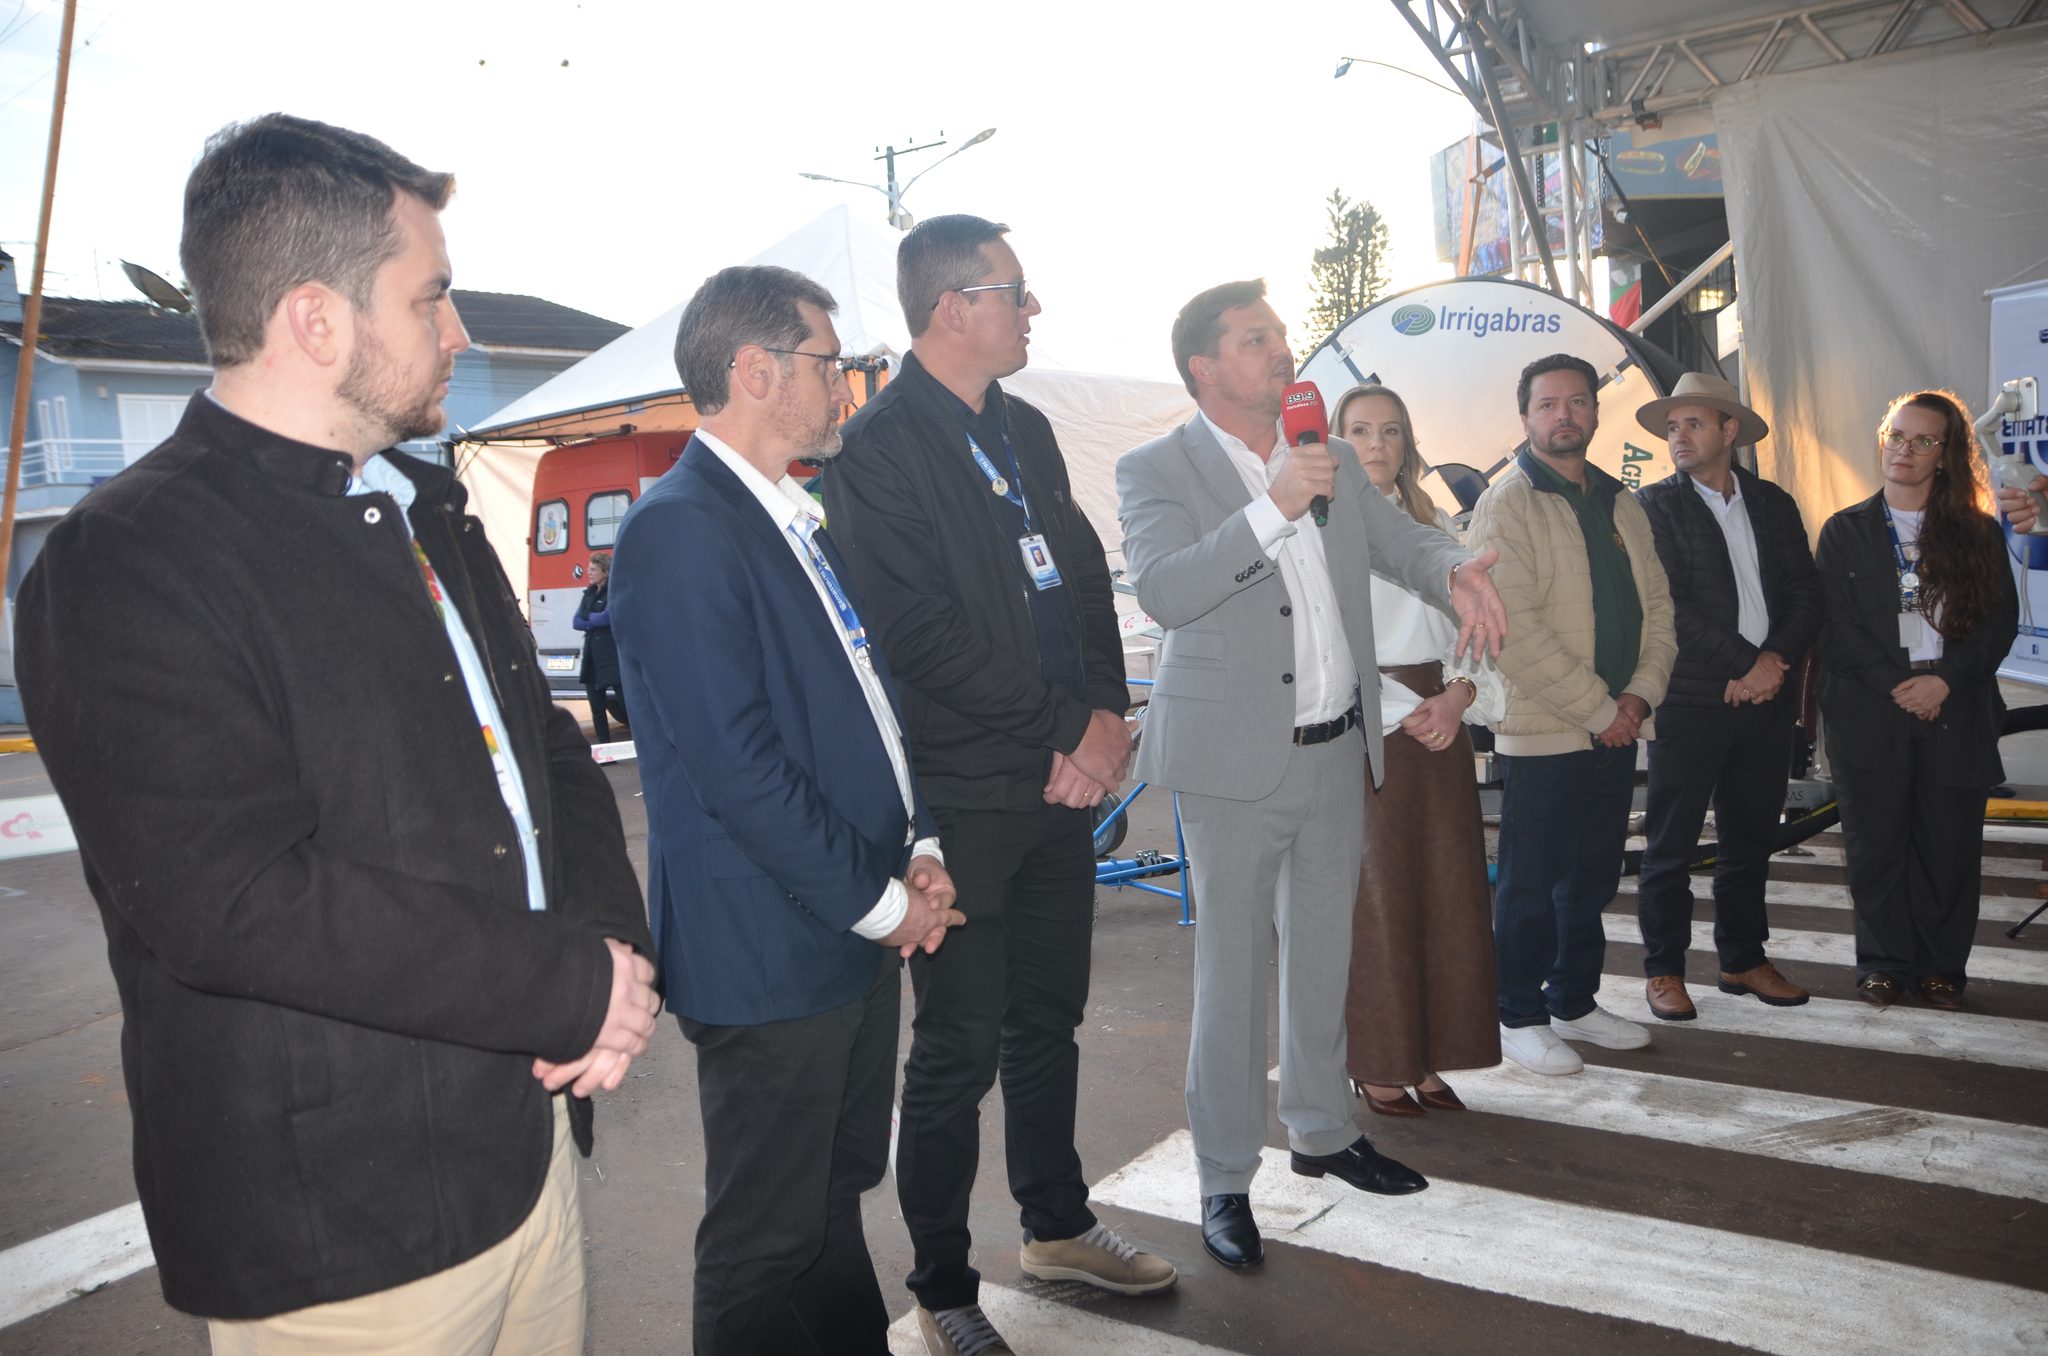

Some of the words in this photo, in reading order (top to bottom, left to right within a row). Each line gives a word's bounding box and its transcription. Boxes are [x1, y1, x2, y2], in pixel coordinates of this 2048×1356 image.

[1440, 305, 1561, 338] Irrigabras
[1286, 391, 1315, 405] 89.9
[2002, 415, 2048, 437] EMAT
